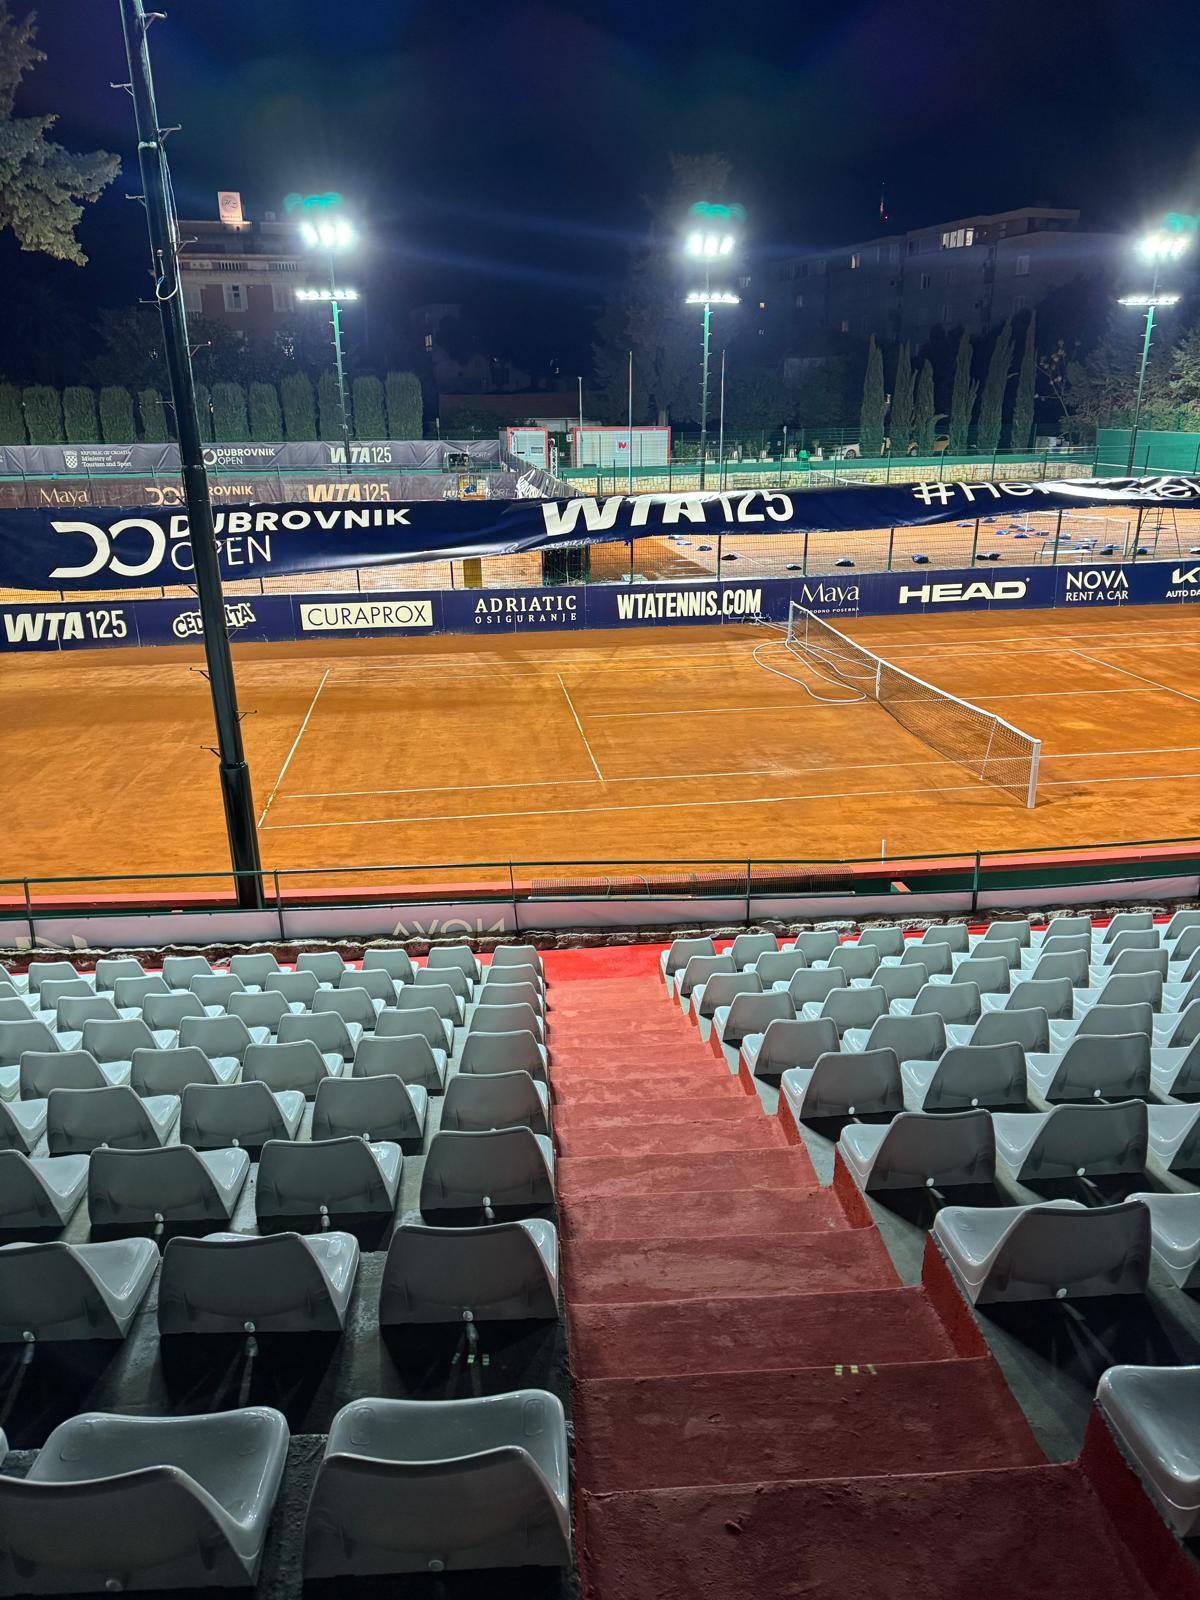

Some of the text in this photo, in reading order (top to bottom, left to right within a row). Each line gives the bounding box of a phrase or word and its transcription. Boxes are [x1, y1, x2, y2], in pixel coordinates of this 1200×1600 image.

[217, 448, 275, 456] DUBROVNIK
[218, 457, 243, 465] OPEN
[330, 446, 392, 463] WTA 125
[40, 488, 88, 506] Maya
[307, 483, 391, 502] WTA 125
[541, 489, 793, 536] WTA 125
[1066, 570, 1129, 590] NOVA
[800, 582, 860, 607] Maya
[899, 582, 1026, 604] HEAD
[1065, 590, 1129, 602] RENT A CAR
[1165, 589, 1189, 598] AUTO
[474, 595, 577, 614] ADRIATIC
[617, 588, 762, 620] WTATENNIS.COM
[172, 602, 256, 638] CEDITA
[307, 604, 427, 627] CURAPROX
[474, 612, 577, 625] OSIGURANJE
[3, 609, 127, 643] WTA 125
